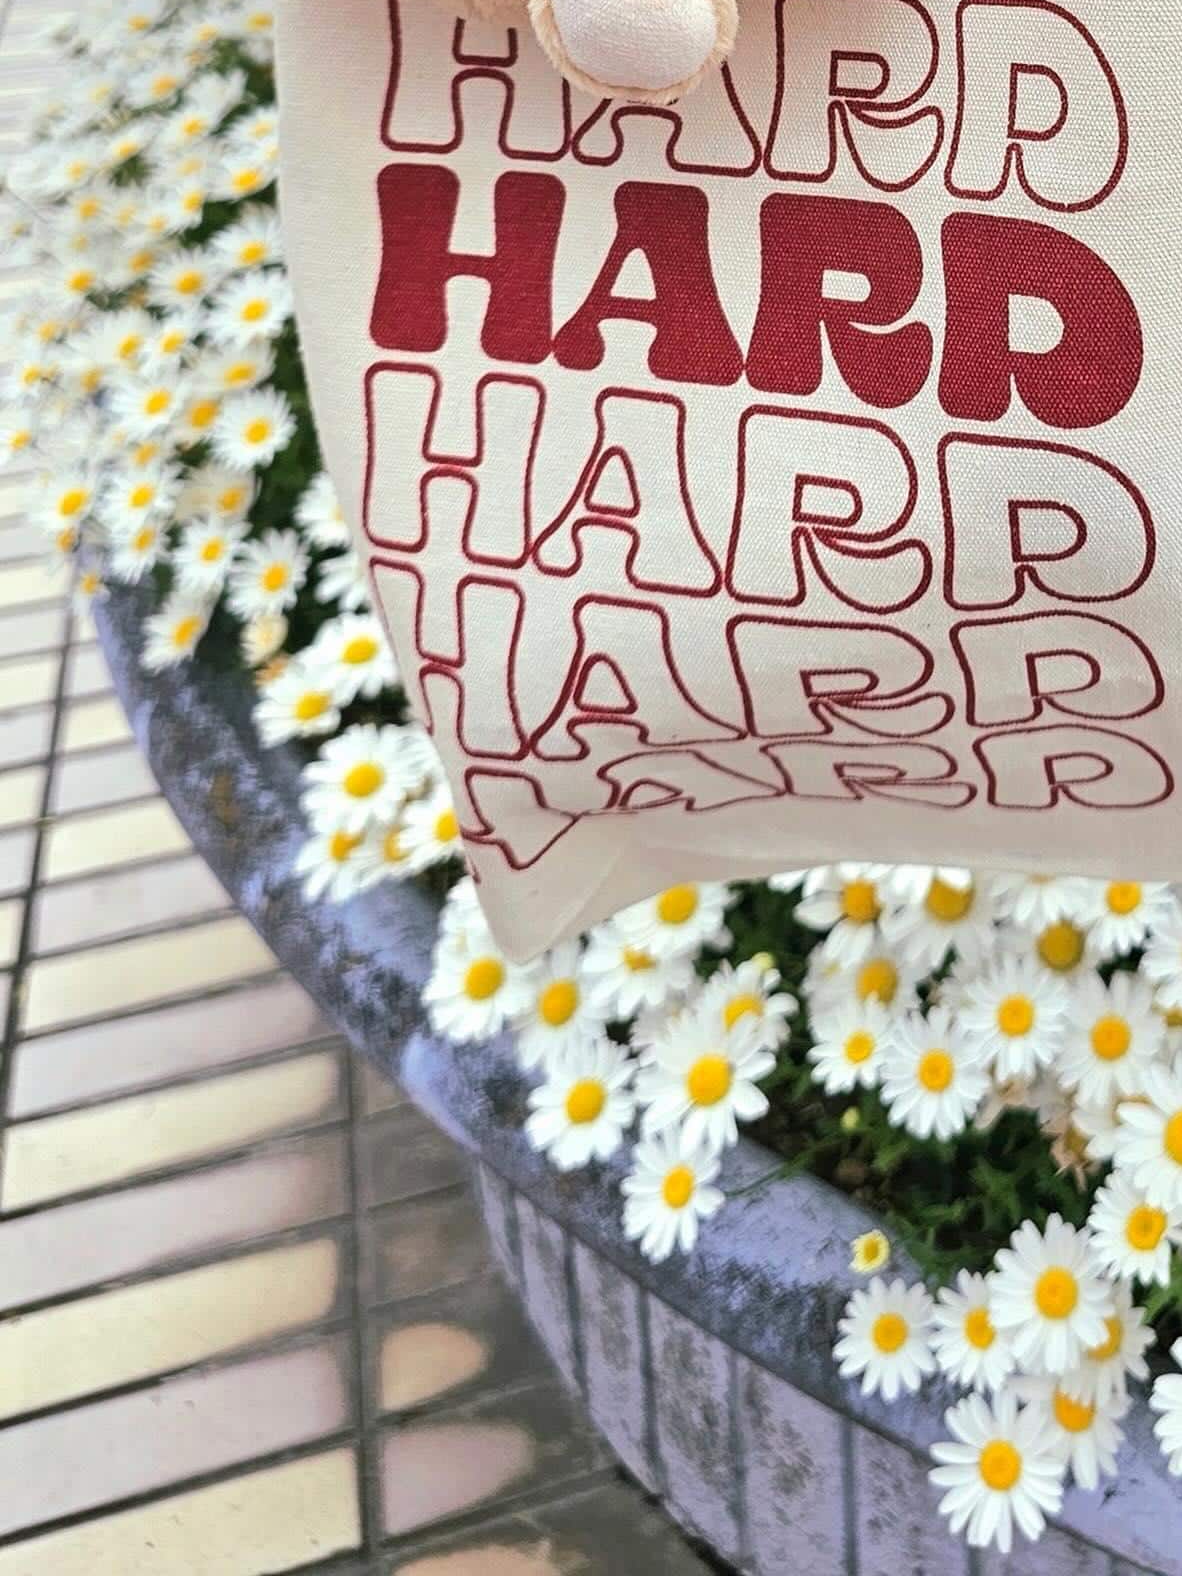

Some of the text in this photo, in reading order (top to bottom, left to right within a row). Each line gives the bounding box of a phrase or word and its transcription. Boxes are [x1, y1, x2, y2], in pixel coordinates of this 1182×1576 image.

[369, 163, 1144, 428] HARD
[363, 361, 1156, 614] HARD
[369, 558, 1165, 762] HARD
